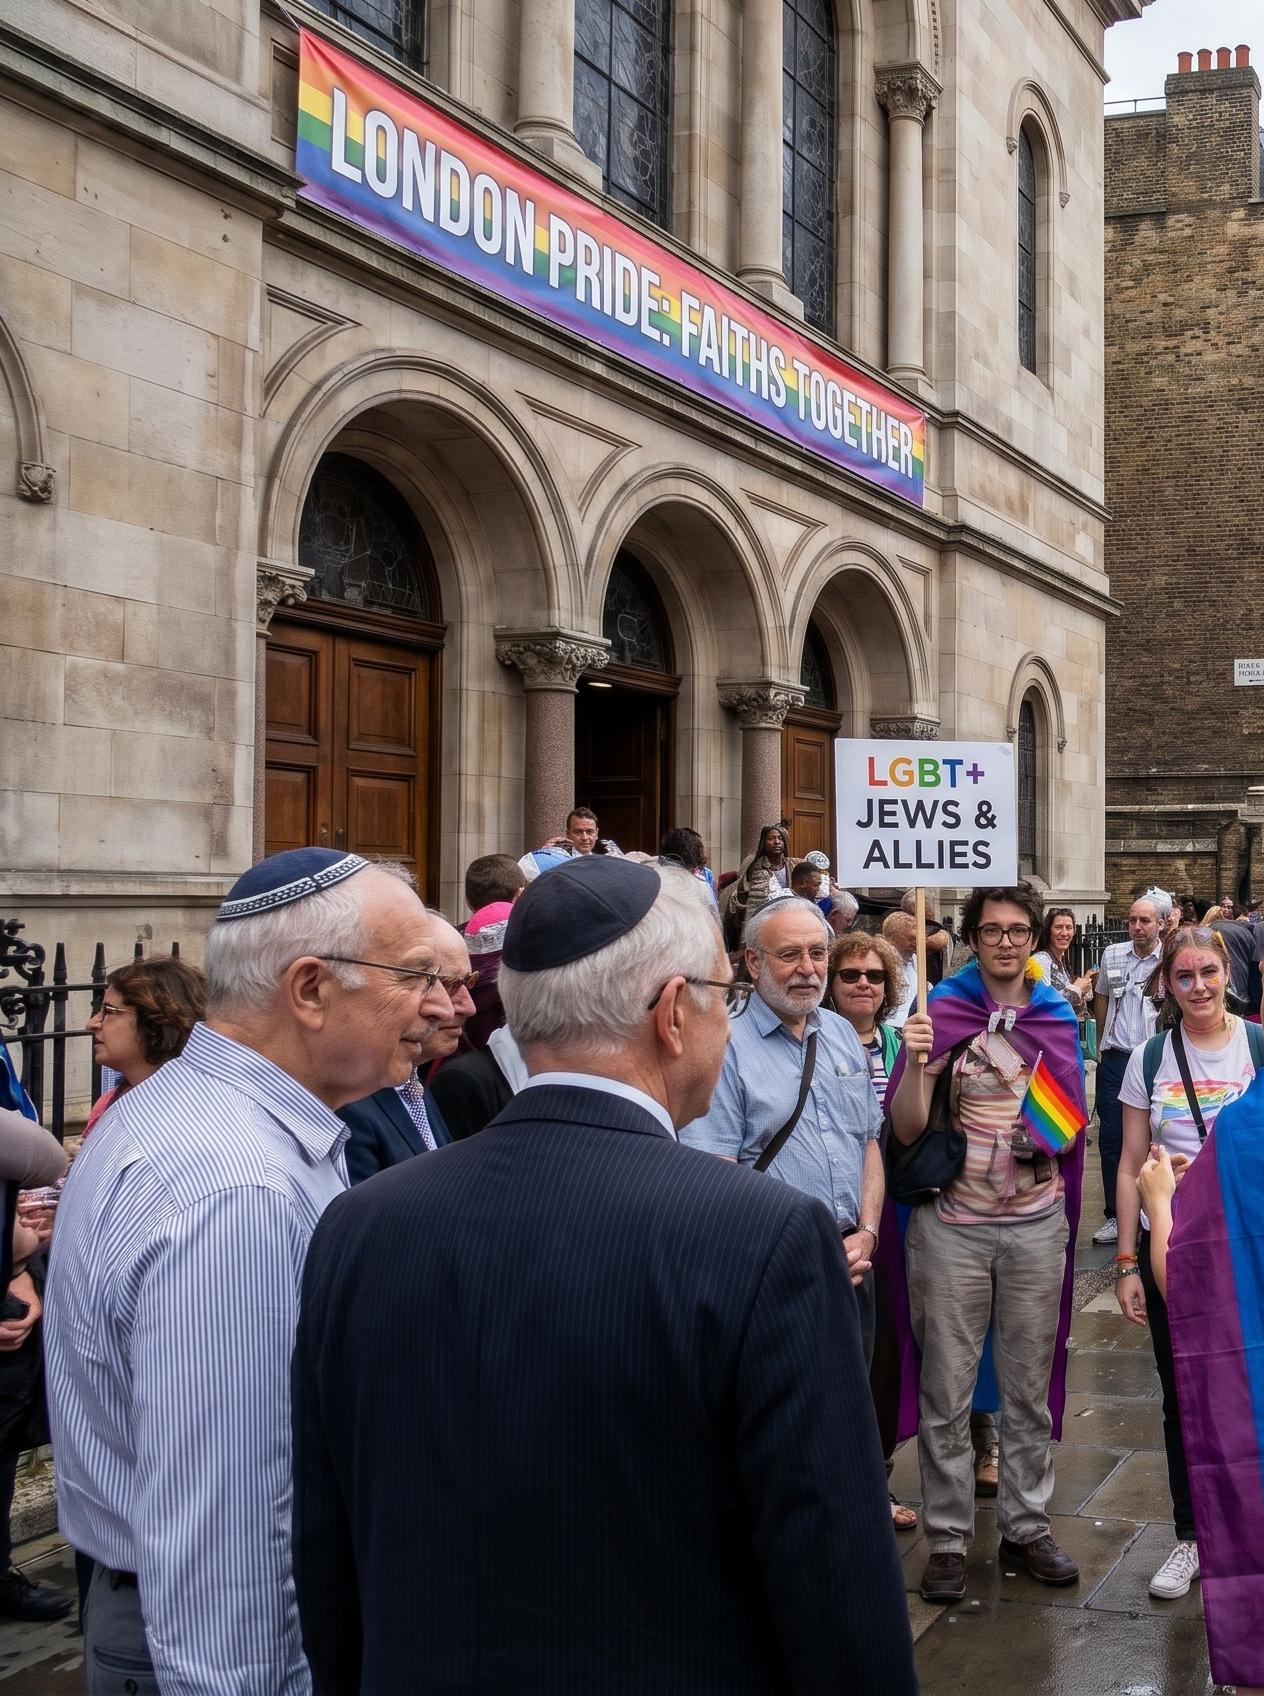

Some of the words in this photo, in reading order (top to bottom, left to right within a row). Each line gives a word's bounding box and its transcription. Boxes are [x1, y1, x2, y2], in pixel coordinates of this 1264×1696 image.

[330, 86, 537, 276] LONDON
[548, 211, 672, 348] PRIDE:
[679, 289, 787, 409] FAITHS
[792, 357, 915, 480] TOGETHER
[867, 756, 985, 789] LGBT+
[855, 798, 962, 830] JEWS
[974, 800, 998, 830] &
[862, 838, 992, 870] ALLIES
